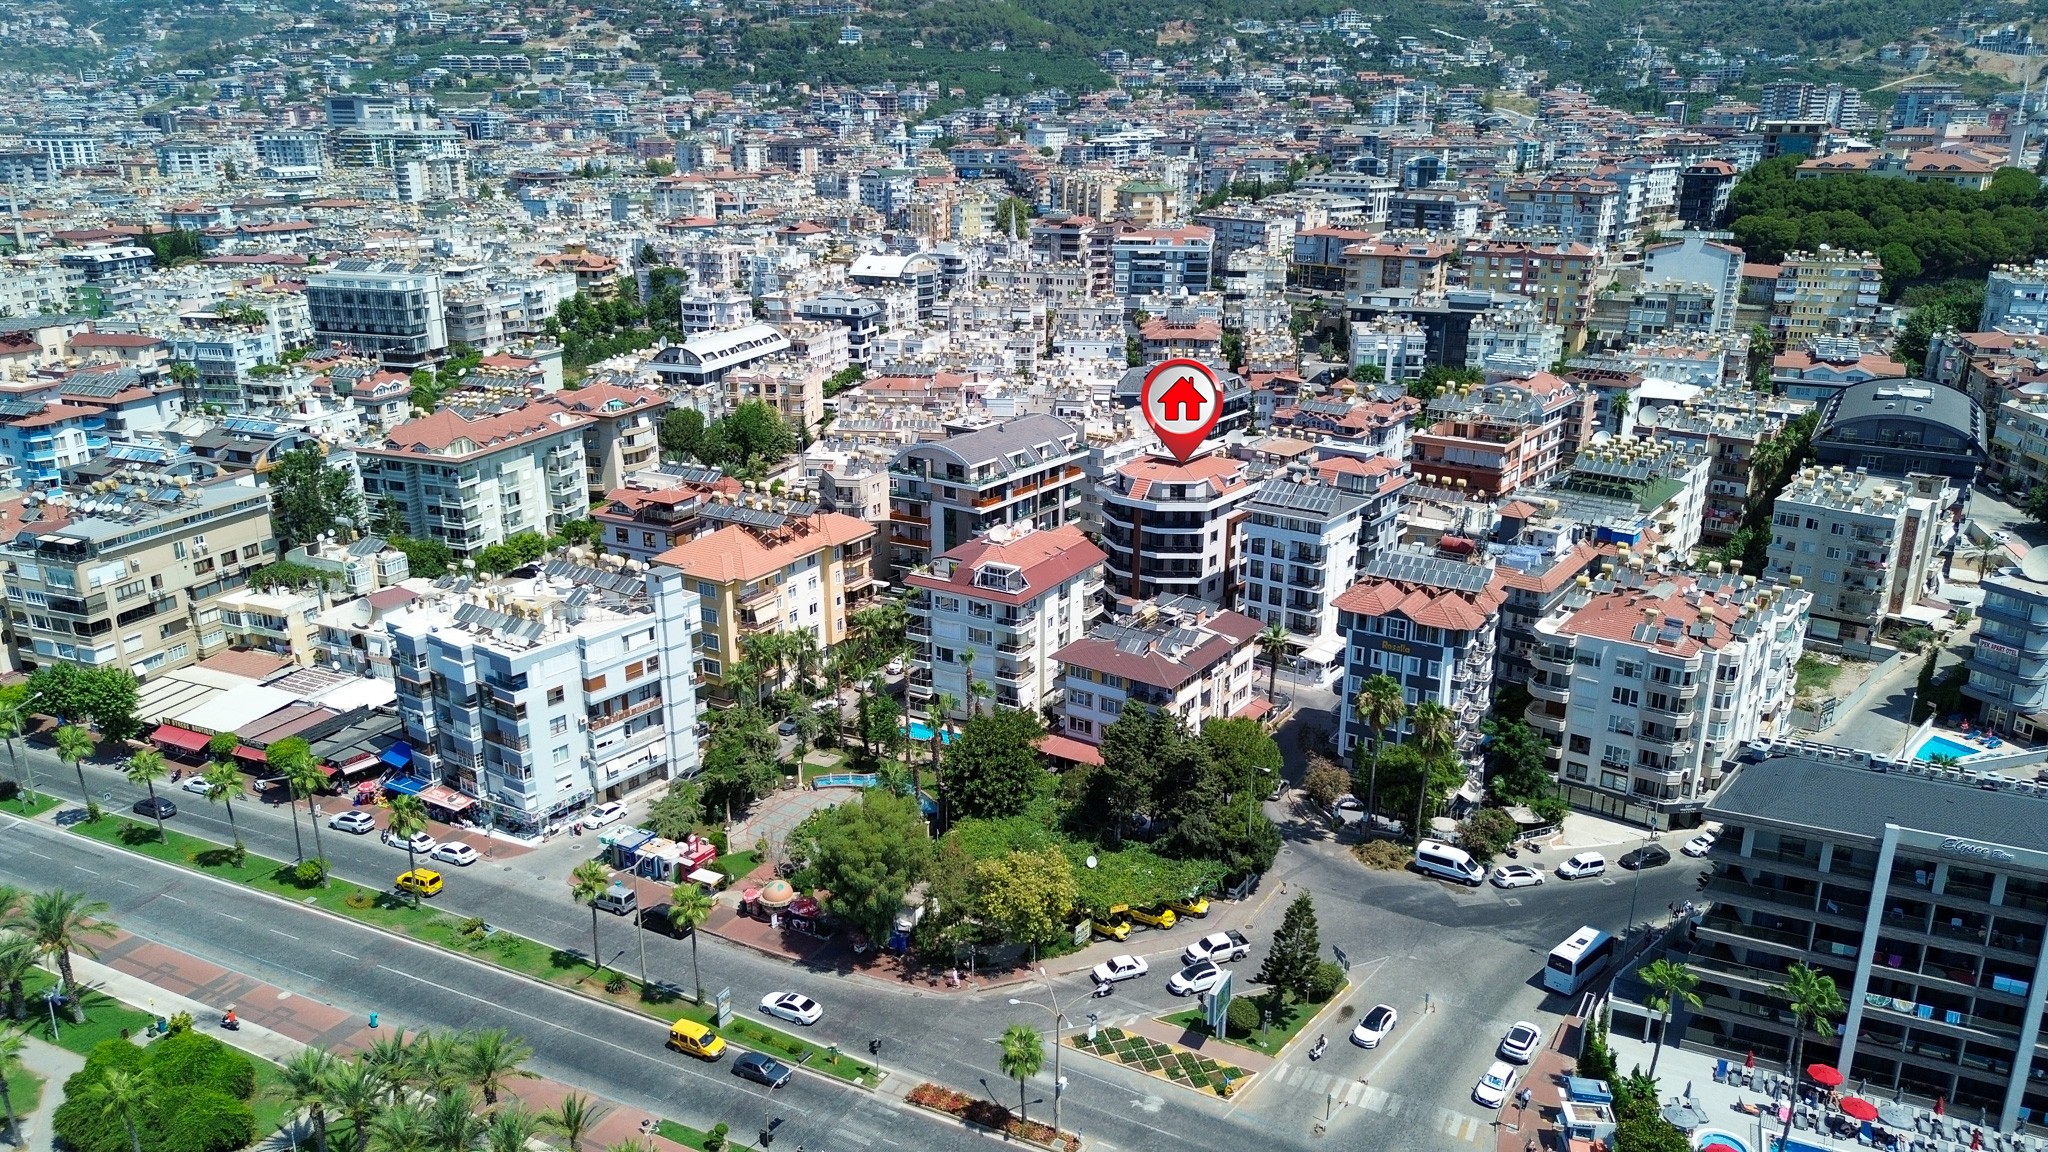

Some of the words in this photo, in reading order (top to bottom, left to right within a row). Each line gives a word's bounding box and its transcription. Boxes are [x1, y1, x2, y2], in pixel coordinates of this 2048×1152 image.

[2006, 648, 2017, 657] OTEL
[172, 719, 190, 730] STRESS
[191, 725, 215, 736] BOUTIQUE
